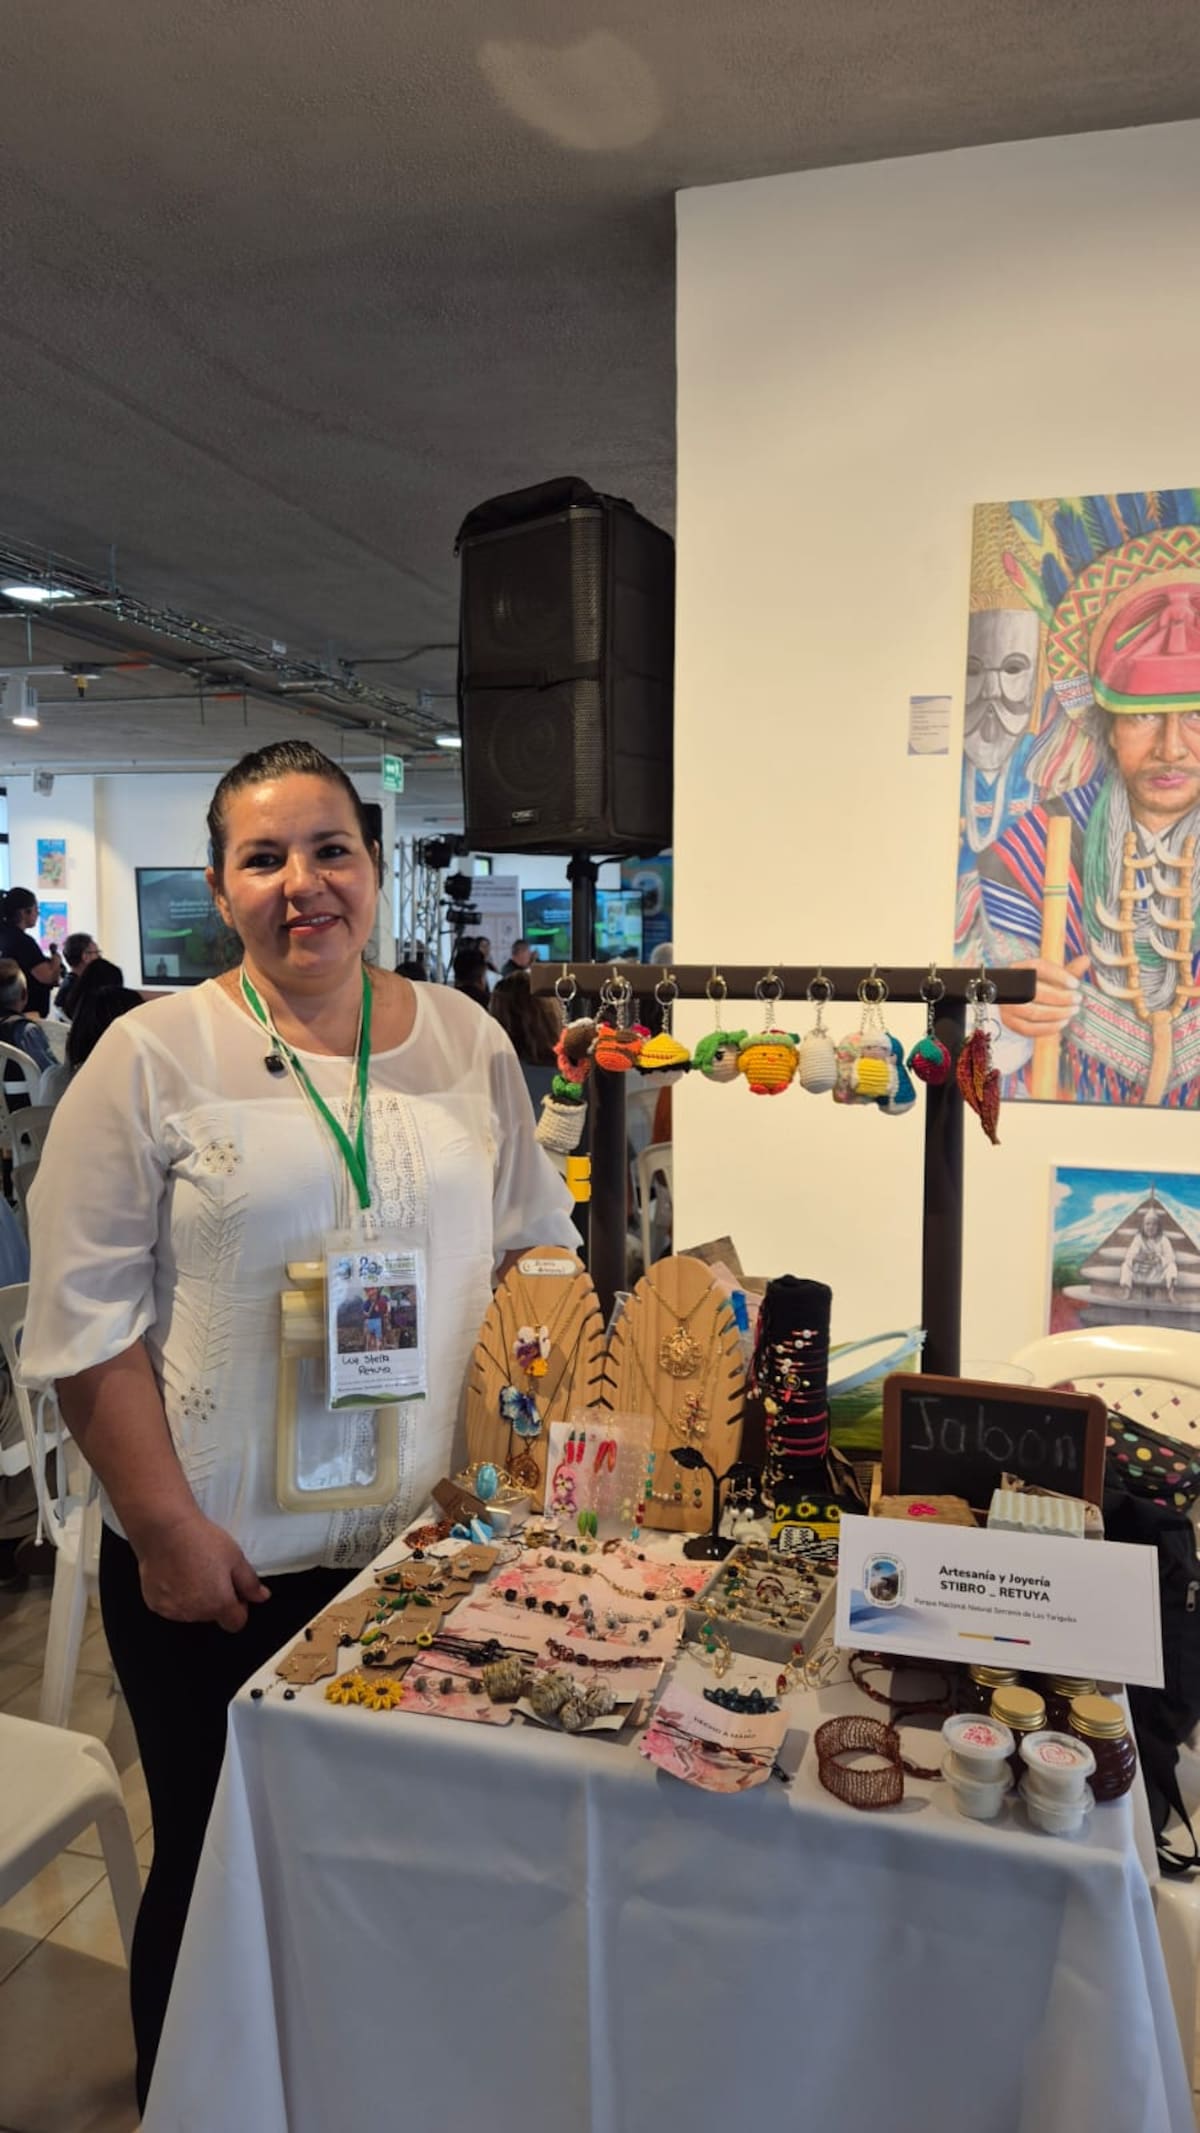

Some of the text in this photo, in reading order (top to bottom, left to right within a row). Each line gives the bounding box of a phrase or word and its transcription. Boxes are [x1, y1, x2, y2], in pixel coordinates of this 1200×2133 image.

[939, 1565, 1051, 1587] Artesanía y Joyería
[940, 1580, 986, 1595] STIBRO
[1000, 1587, 1051, 1602] RETUYA
[938, 1600, 966, 1610] Nacional
[968, 1603, 992, 1613] Natural
